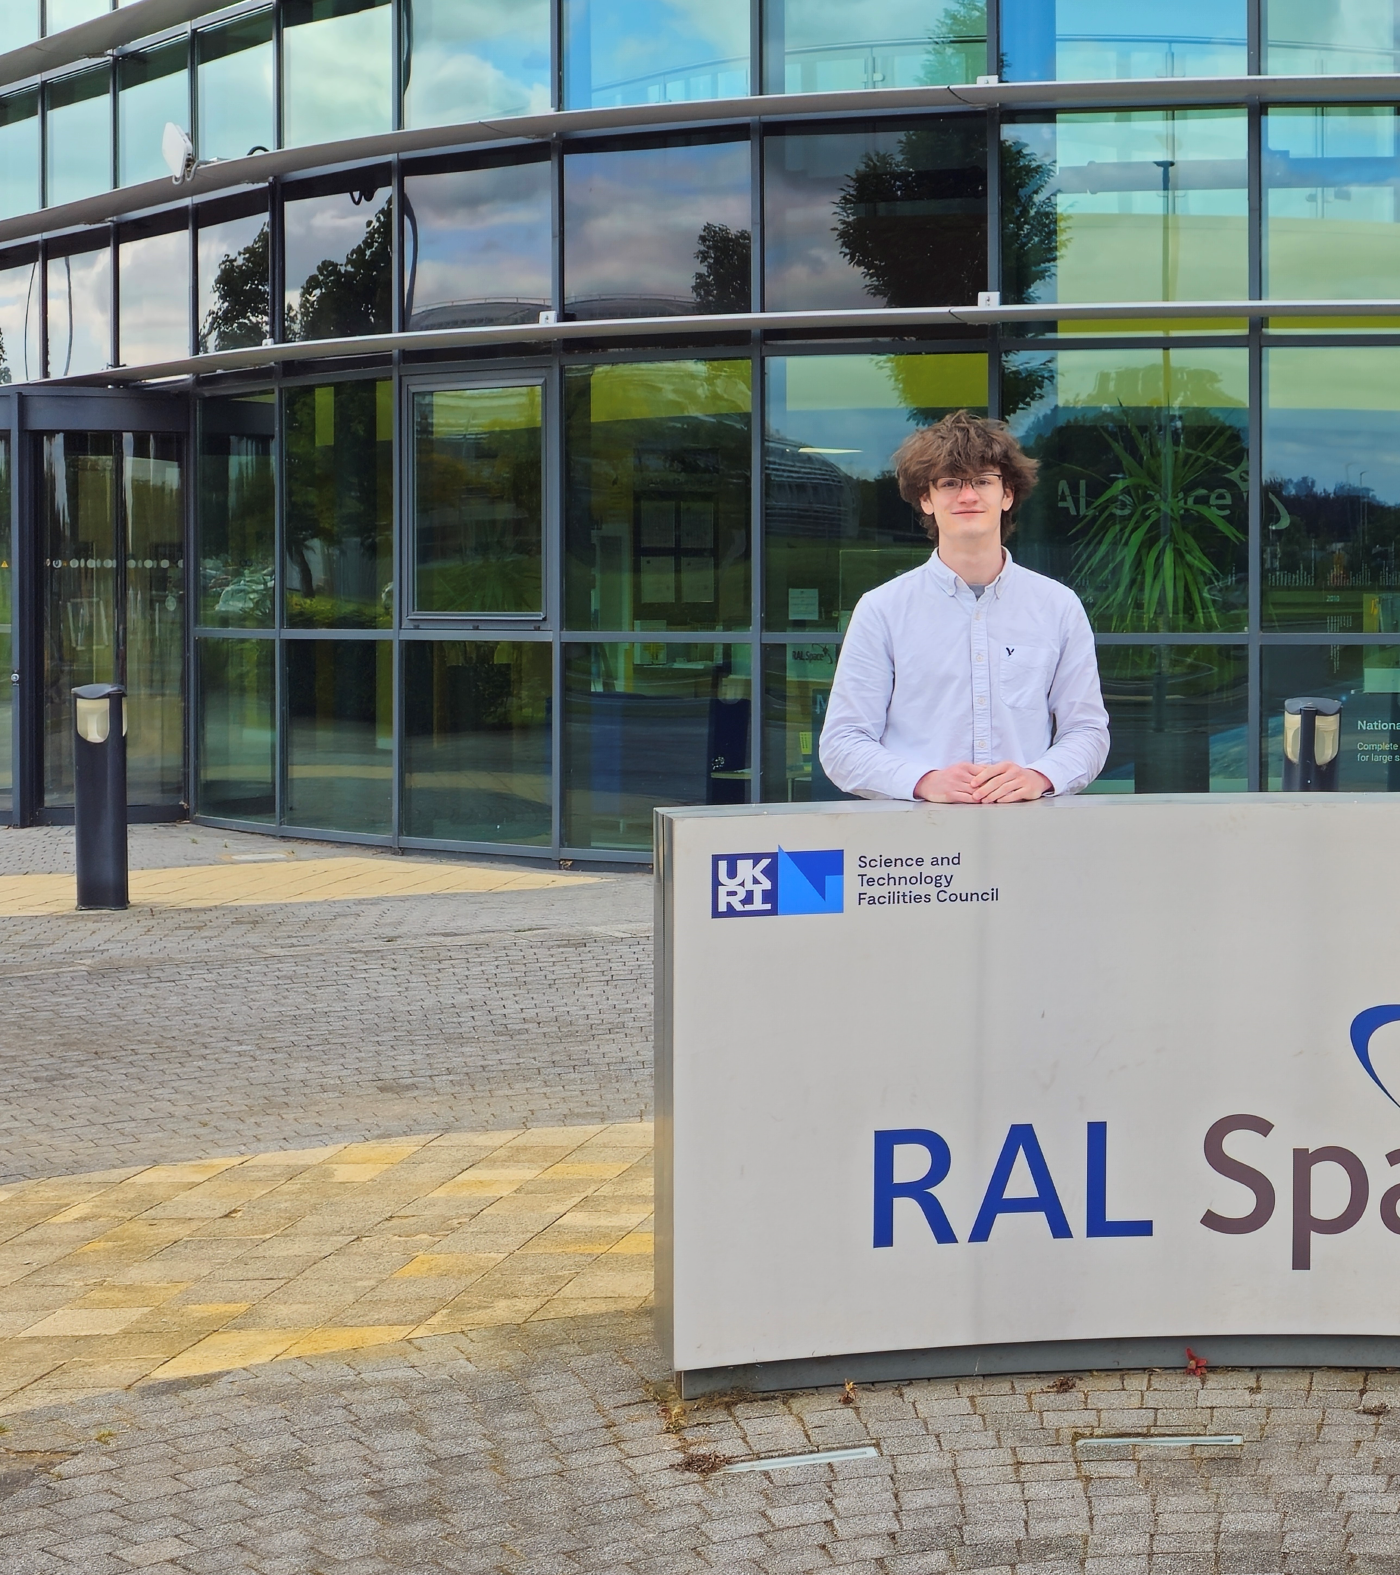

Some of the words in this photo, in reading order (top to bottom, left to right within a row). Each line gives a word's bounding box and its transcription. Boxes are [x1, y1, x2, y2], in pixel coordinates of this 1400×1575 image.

[1357, 742, 1399, 752] Complete
[1357, 753, 1369, 762] for
[1371, 753, 1393, 764] large
[858, 854, 925, 868] Science
[930, 852, 961, 867] and
[857, 871, 954, 888] Technology
[858, 890, 932, 906] Facilities
[936, 888, 999, 903] Council
[872, 1120, 1154, 1249] RAL
